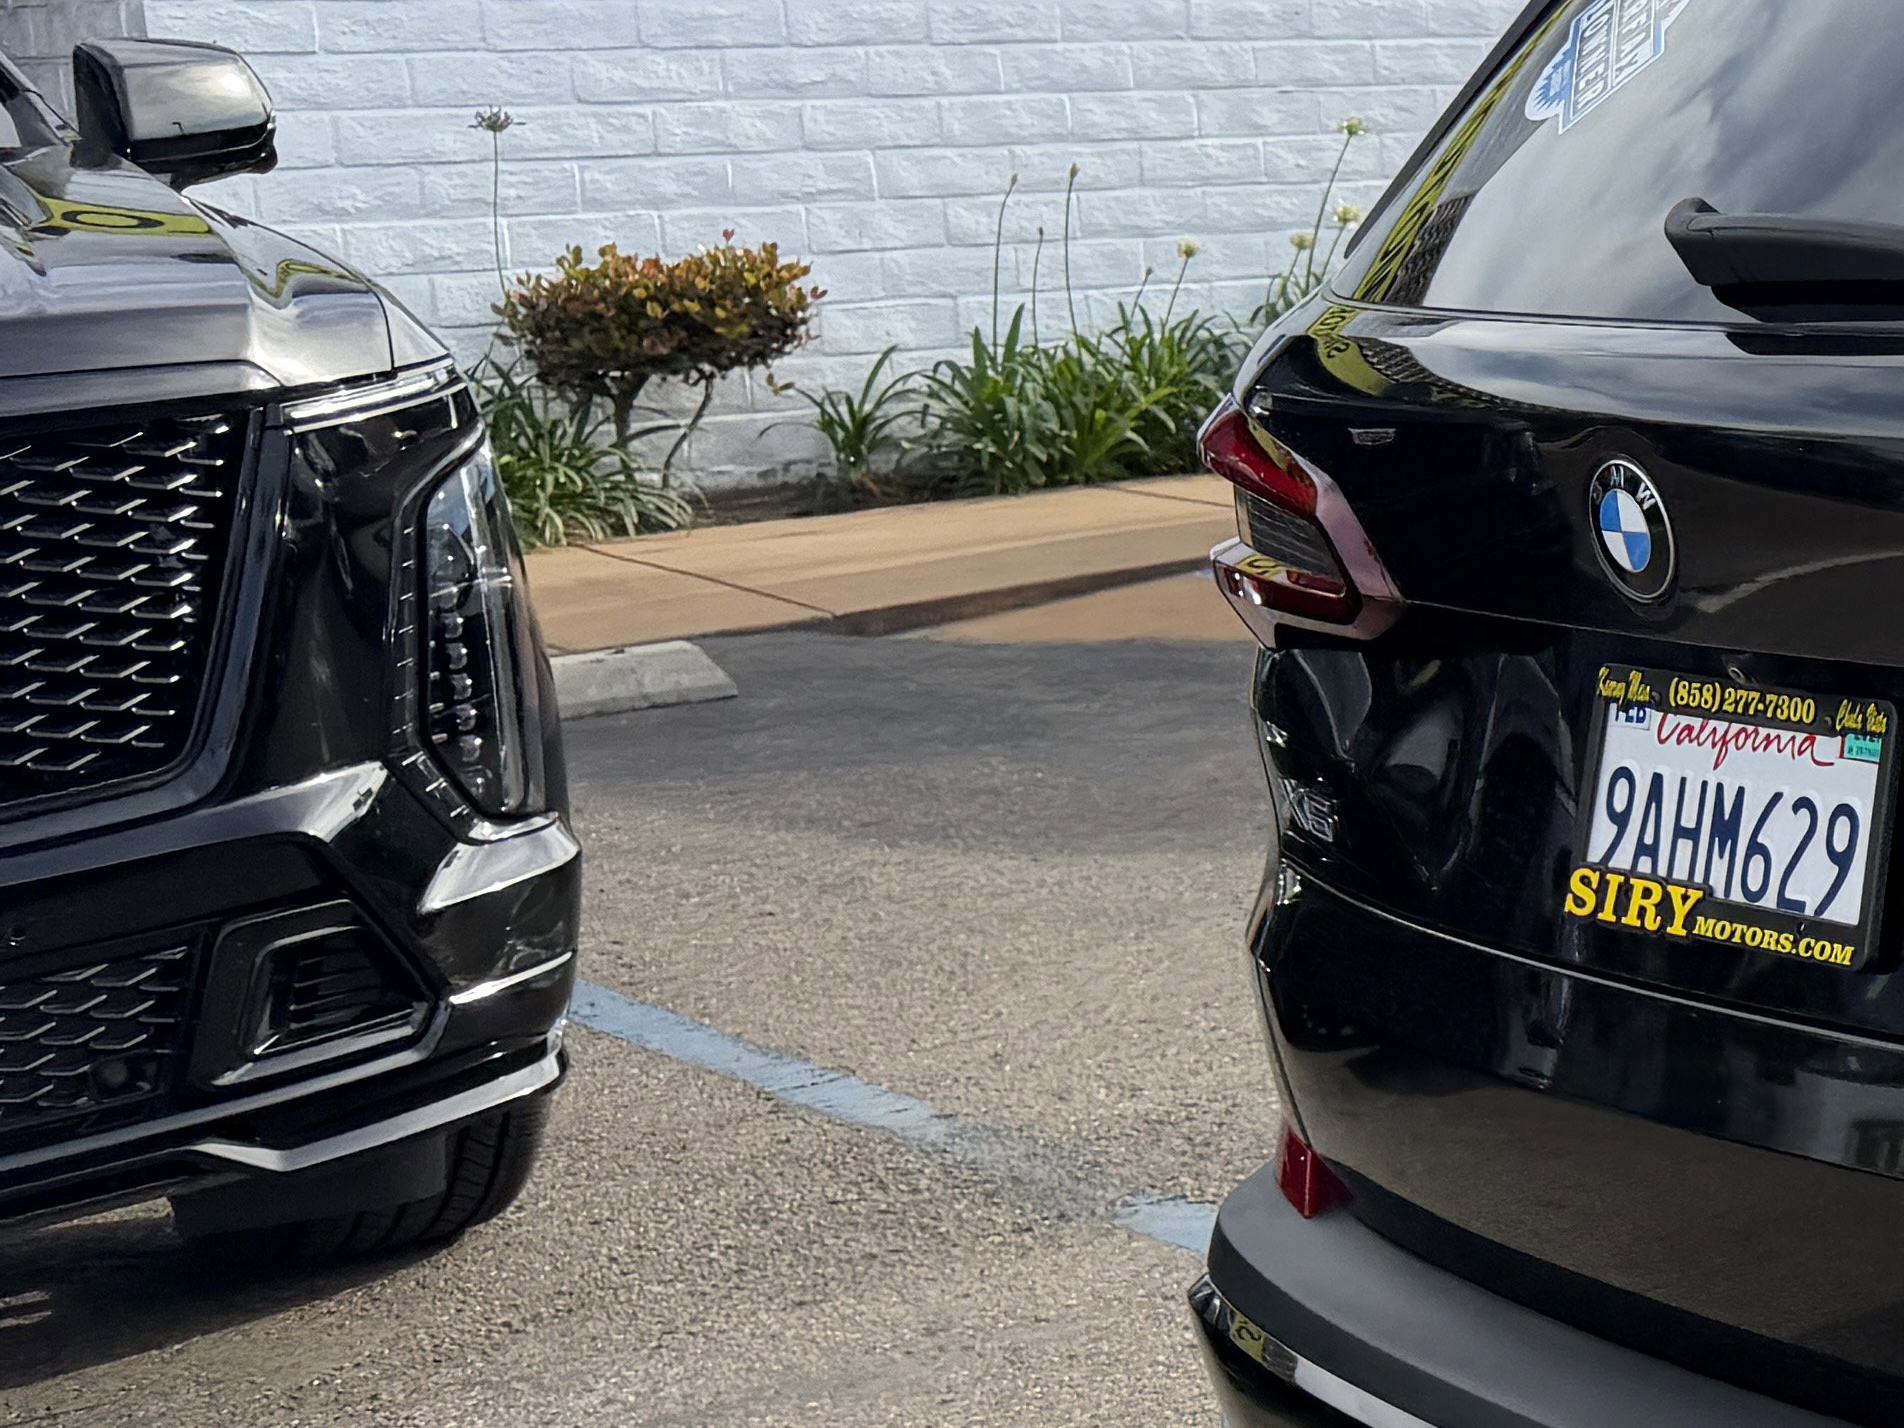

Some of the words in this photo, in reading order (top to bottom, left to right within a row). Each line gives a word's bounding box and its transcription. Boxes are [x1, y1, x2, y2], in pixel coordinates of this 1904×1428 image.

[1591, 464, 1657, 511] BMW
[1668, 676, 1722, 713] (858)
[1721, 686, 1816, 724] 277-7300
[1656, 712, 1836, 771] California
[1599, 765, 1861, 918] 9AHM629
[1563, 866, 1704, 938] SIRY
[1693, 915, 1856, 966] MOTORS.COM
